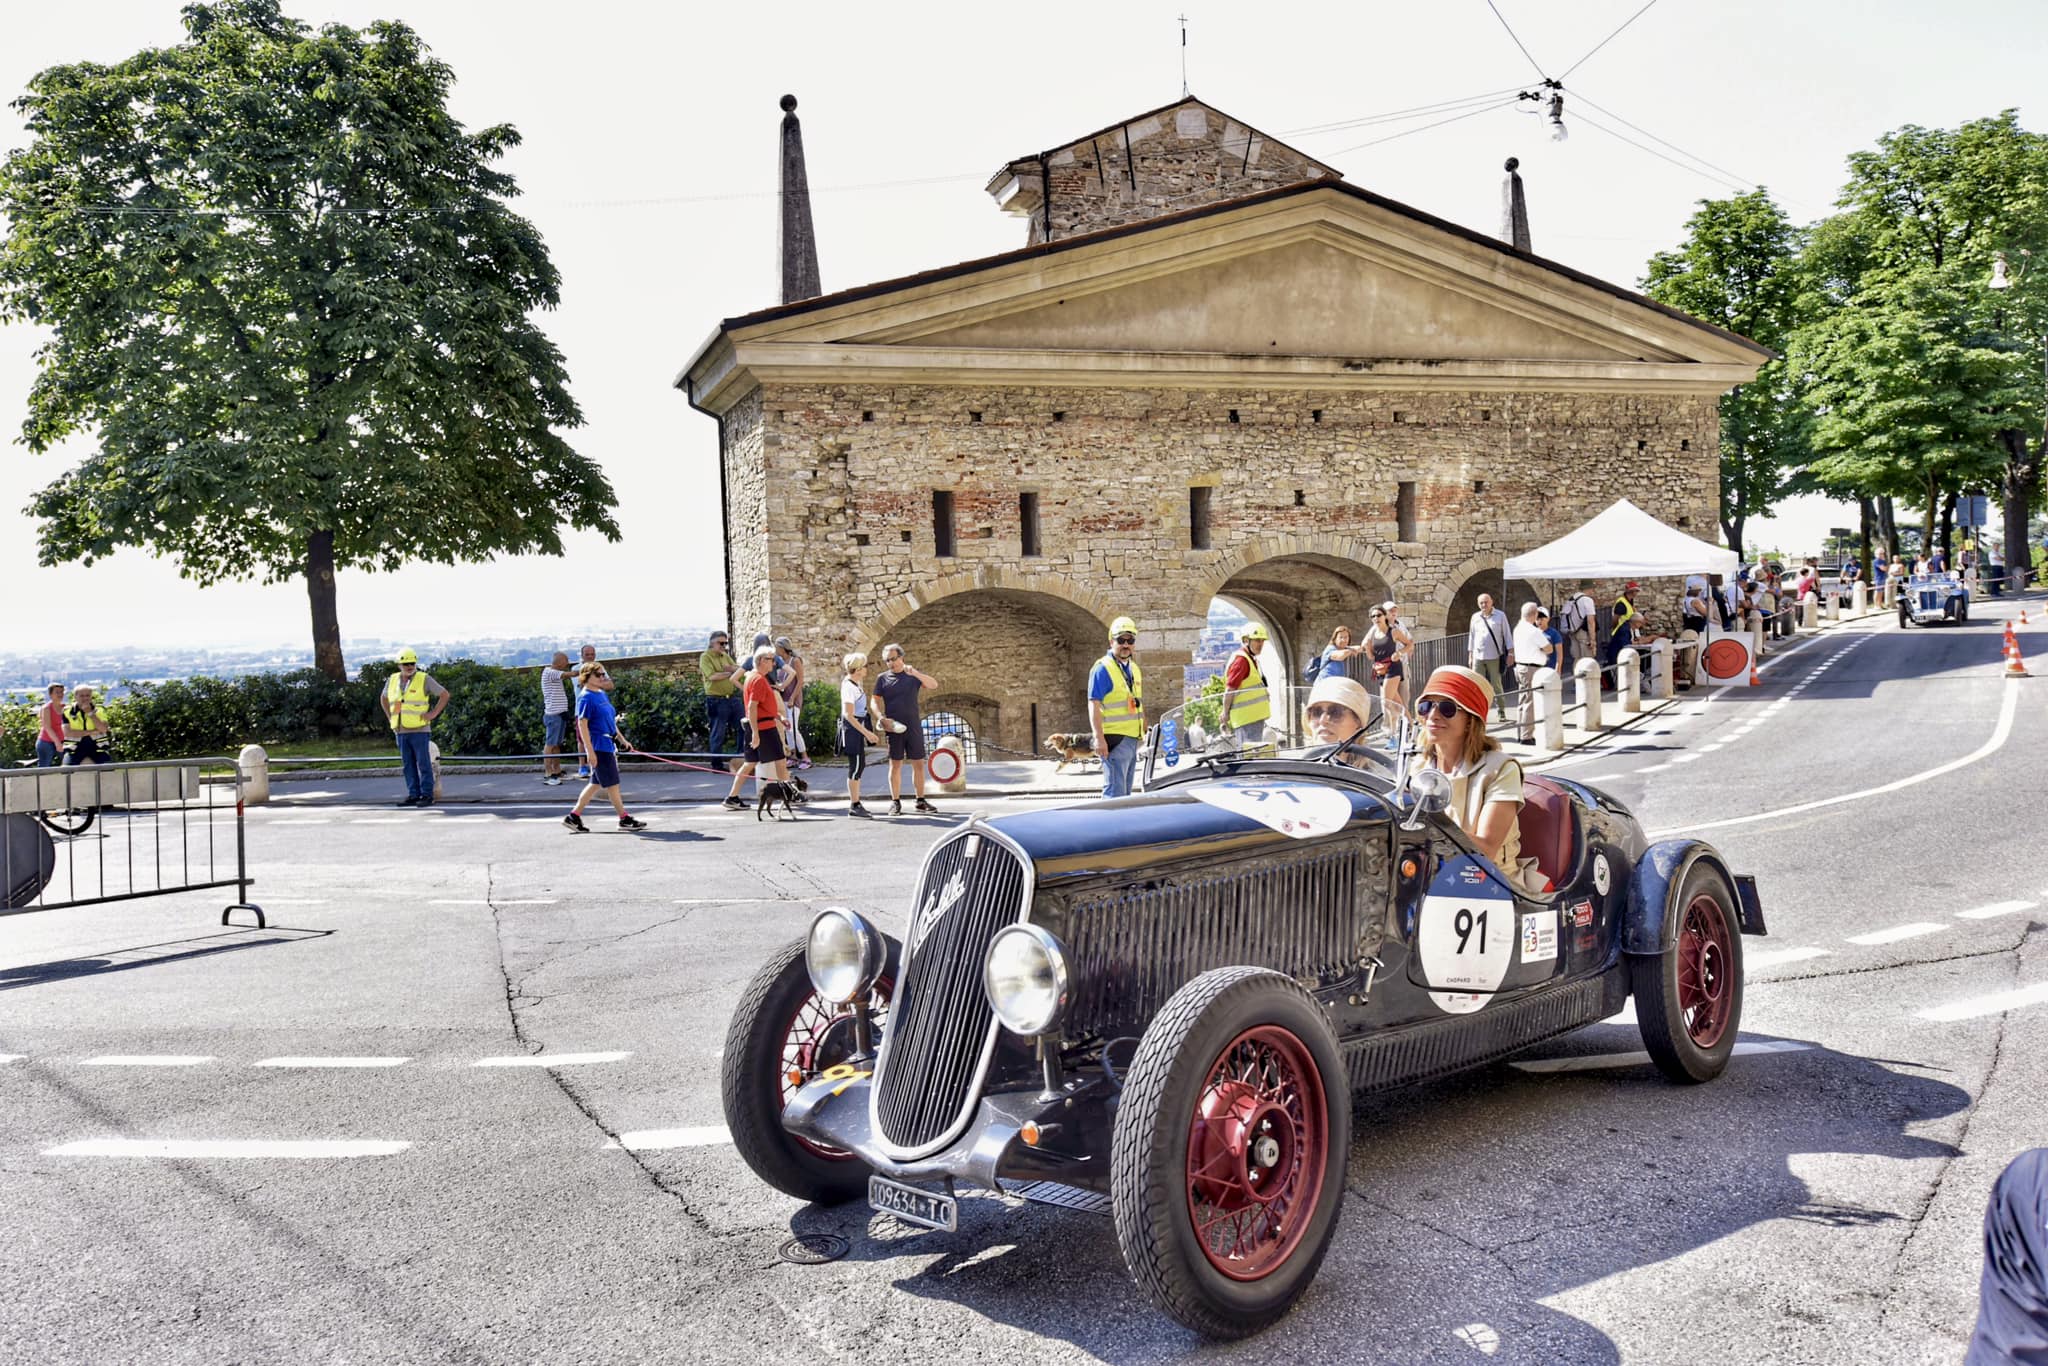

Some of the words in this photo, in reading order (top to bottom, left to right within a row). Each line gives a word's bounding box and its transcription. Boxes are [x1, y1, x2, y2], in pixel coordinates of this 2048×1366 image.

[1240, 789, 1301, 803] 91
[1454, 908, 1488, 954] 91
[808, 1063, 873, 1097] 91
[873, 1183, 917, 1214] 109634
[927, 1198, 951, 1225] TO
